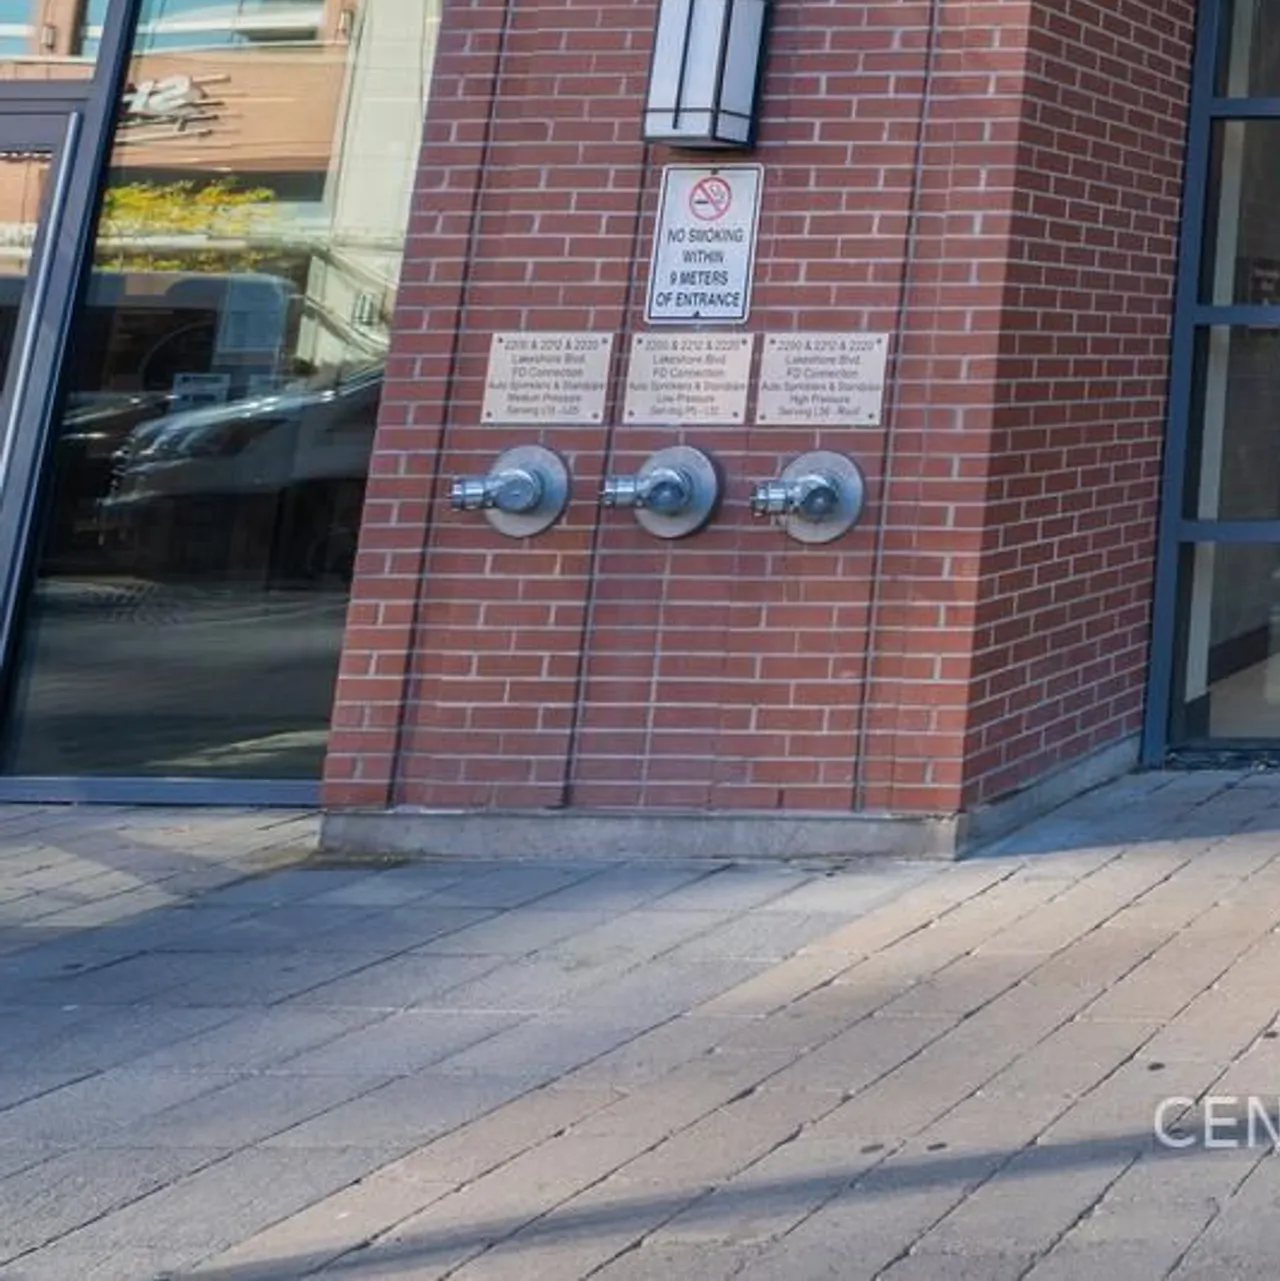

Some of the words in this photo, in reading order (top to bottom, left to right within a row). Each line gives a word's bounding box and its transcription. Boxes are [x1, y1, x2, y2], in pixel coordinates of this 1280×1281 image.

[667, 228, 686, 243] NO
[688, 227, 744, 242] SMOKING
[682, 249, 725, 264] WITHIN
[669, 271, 678, 286] 9
[679, 271, 729, 286] METERS
[655, 292, 674, 307] OF
[675, 292, 741, 308] ENTRANCE
